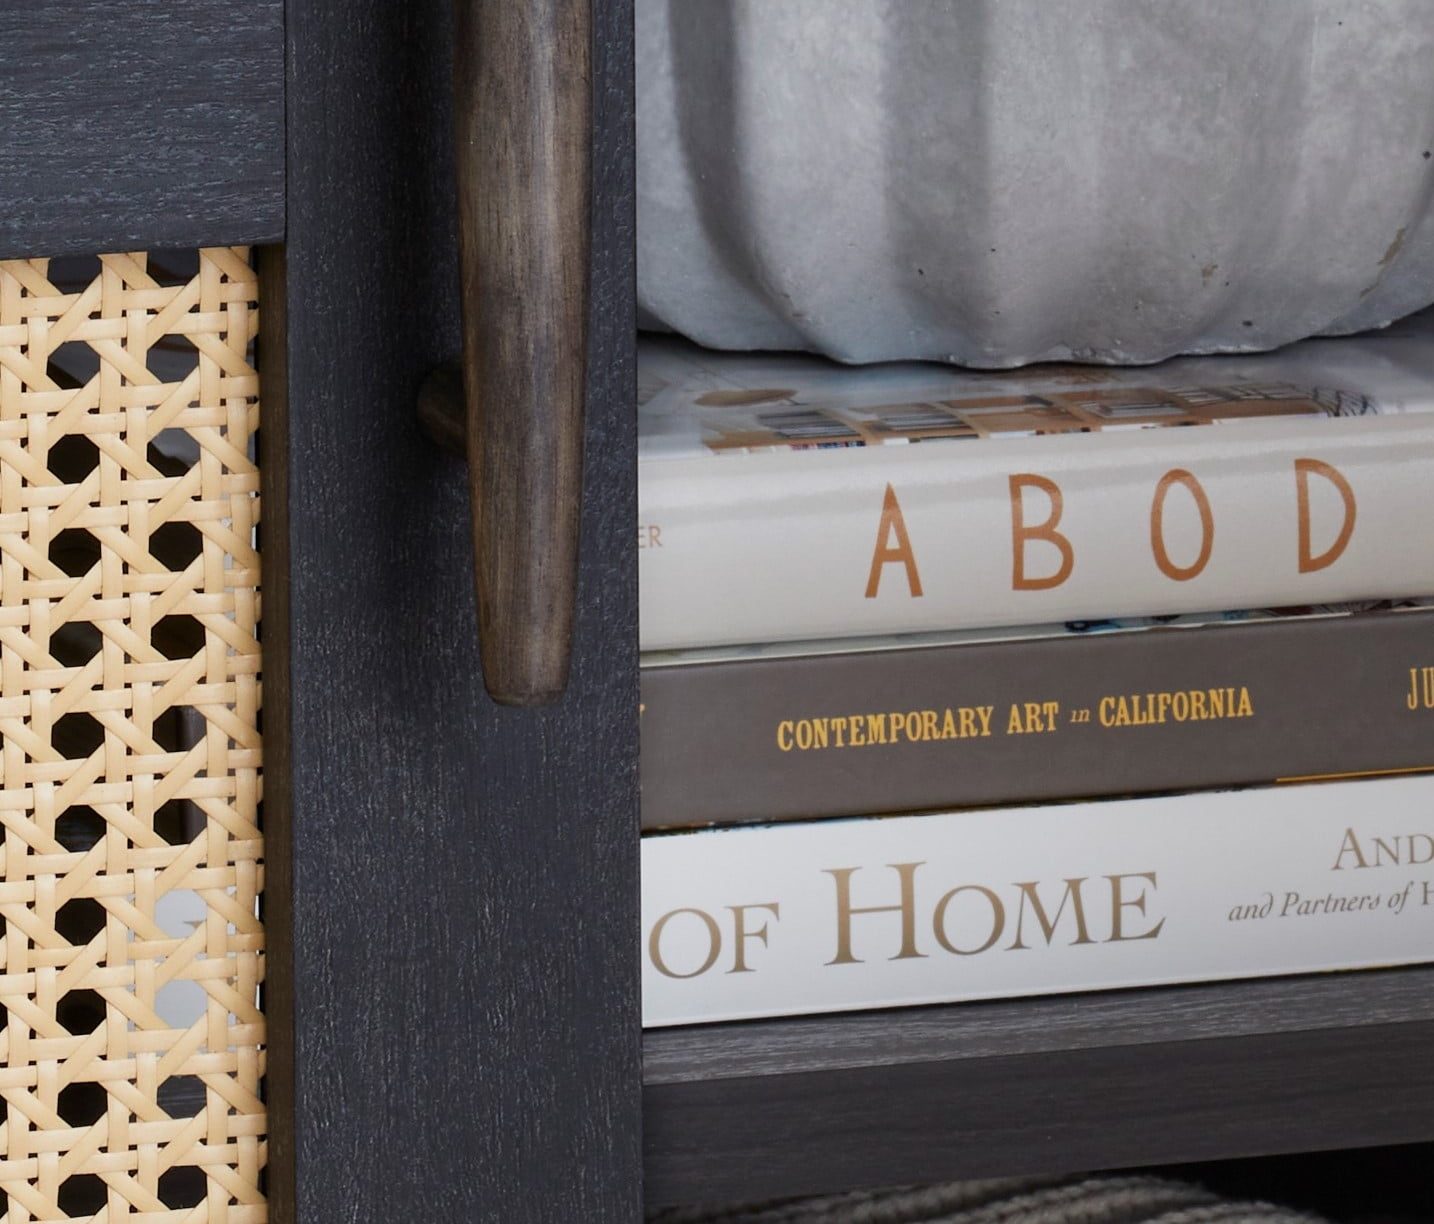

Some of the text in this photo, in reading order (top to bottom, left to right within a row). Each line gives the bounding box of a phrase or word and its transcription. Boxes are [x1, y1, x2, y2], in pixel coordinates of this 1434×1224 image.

[777, 687, 1254, 752] CONTEMPORARY ART in CALIFORNIA
[648, 861, 1167, 979] OF HOME
[1227, 891, 1274, 922] and
[1278, 888, 1381, 919] Partners
[1386, 879, 1414, 916] of
